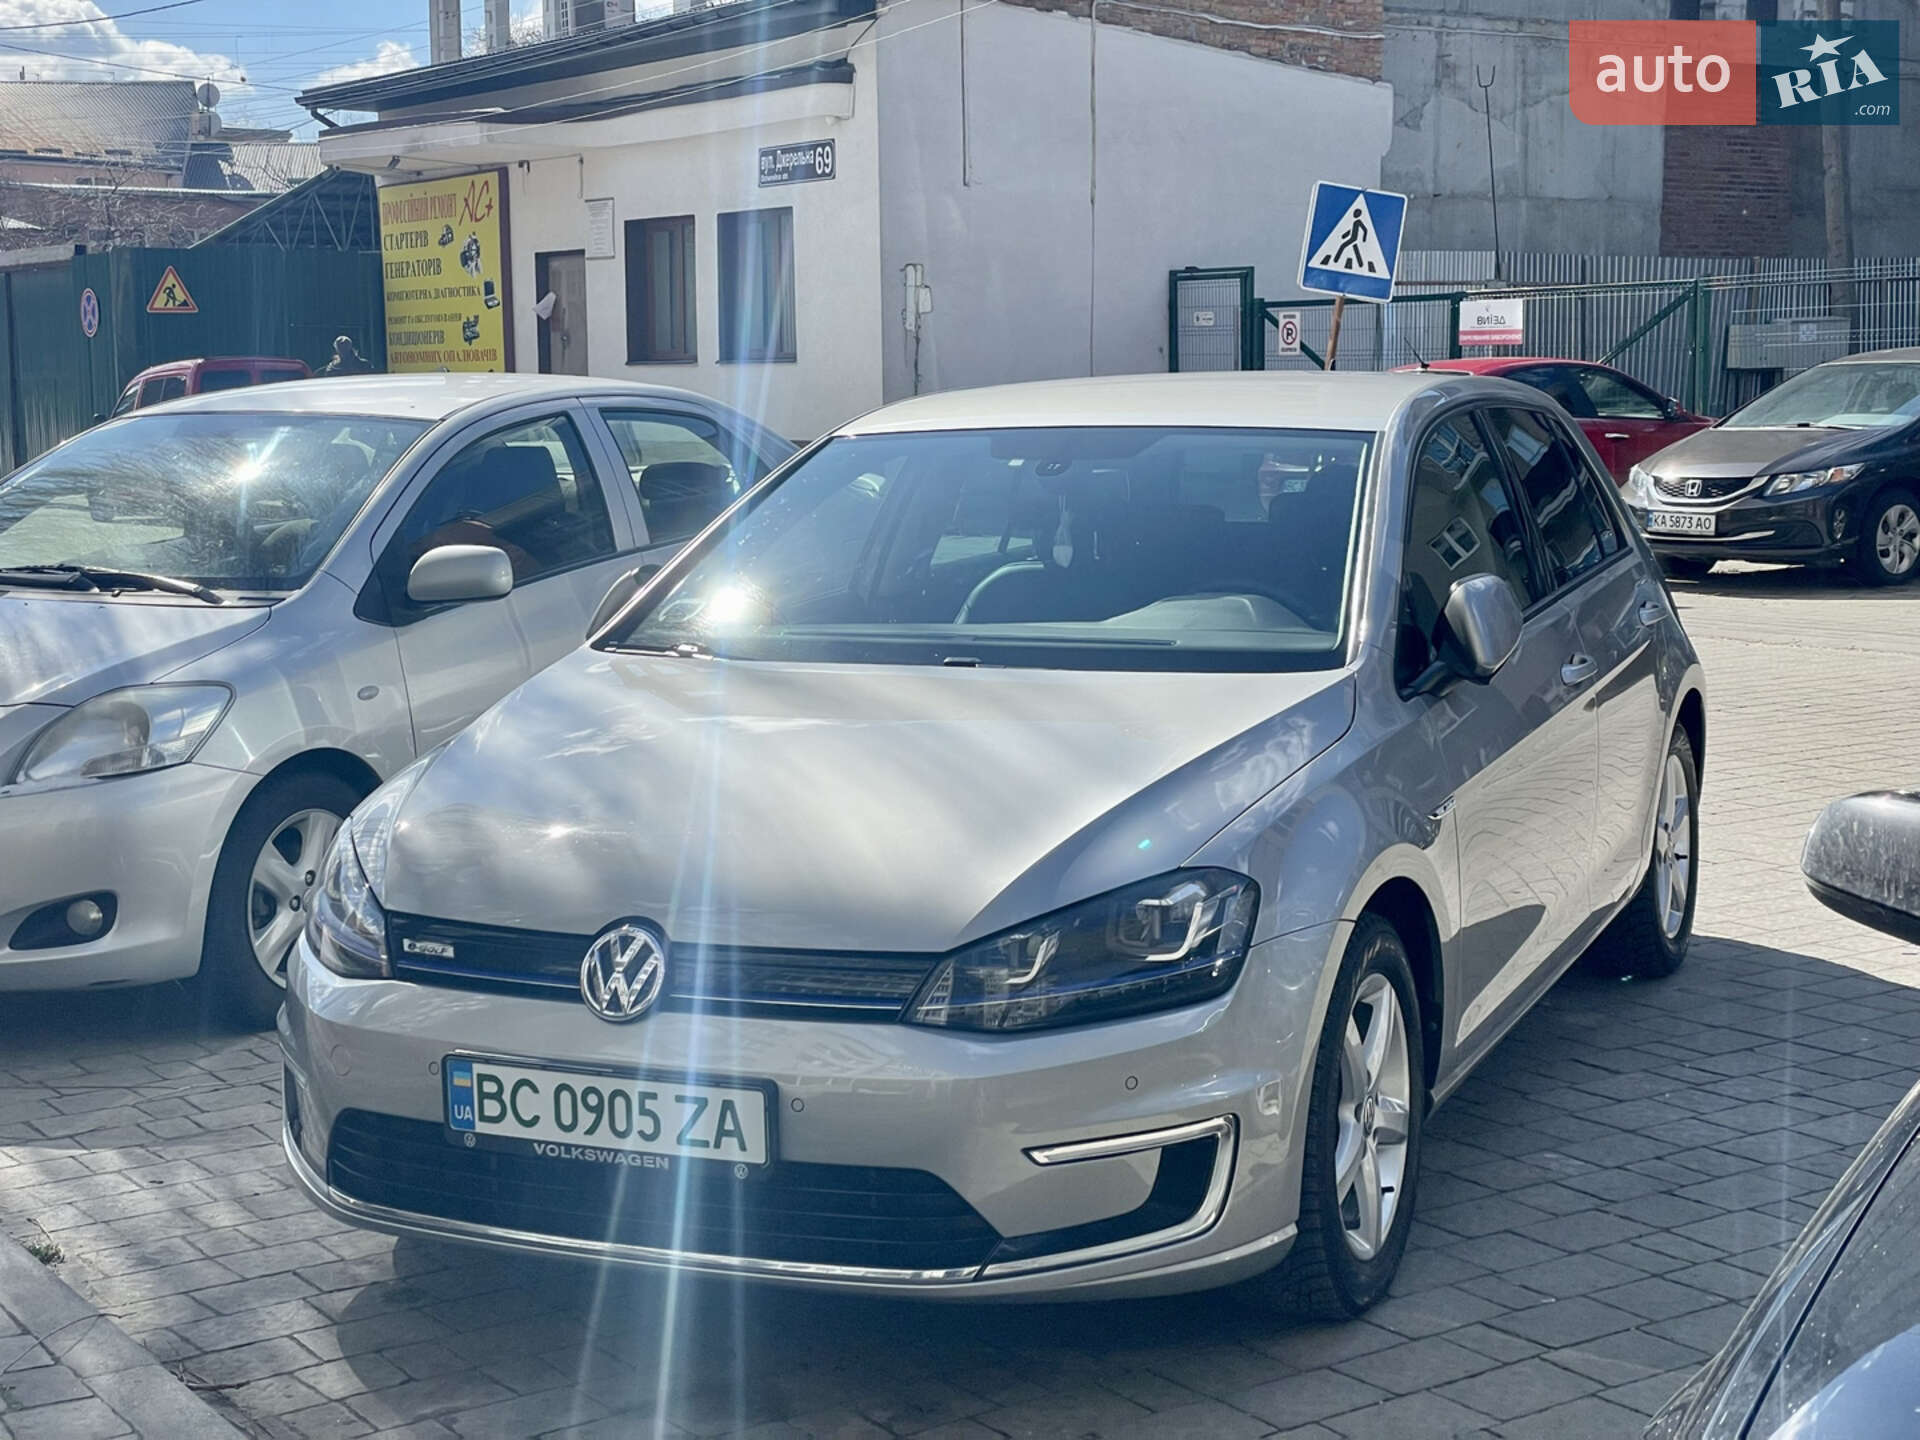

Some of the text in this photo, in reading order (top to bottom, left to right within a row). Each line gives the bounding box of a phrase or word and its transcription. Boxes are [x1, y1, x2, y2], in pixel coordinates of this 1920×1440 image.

[815, 146, 832, 174] 69
[384, 230, 429, 251] СТАРТЕРІВ
[385, 257, 442, 280] ГЕНЕРАТОРІВ
[1669, 515, 1693, 529] 5873
[454, 1104, 473, 1121] UA
[476, 1073, 748, 1152] BC 0905 ZA
[533, 1142, 671, 1170] VOLKSWAGEN
